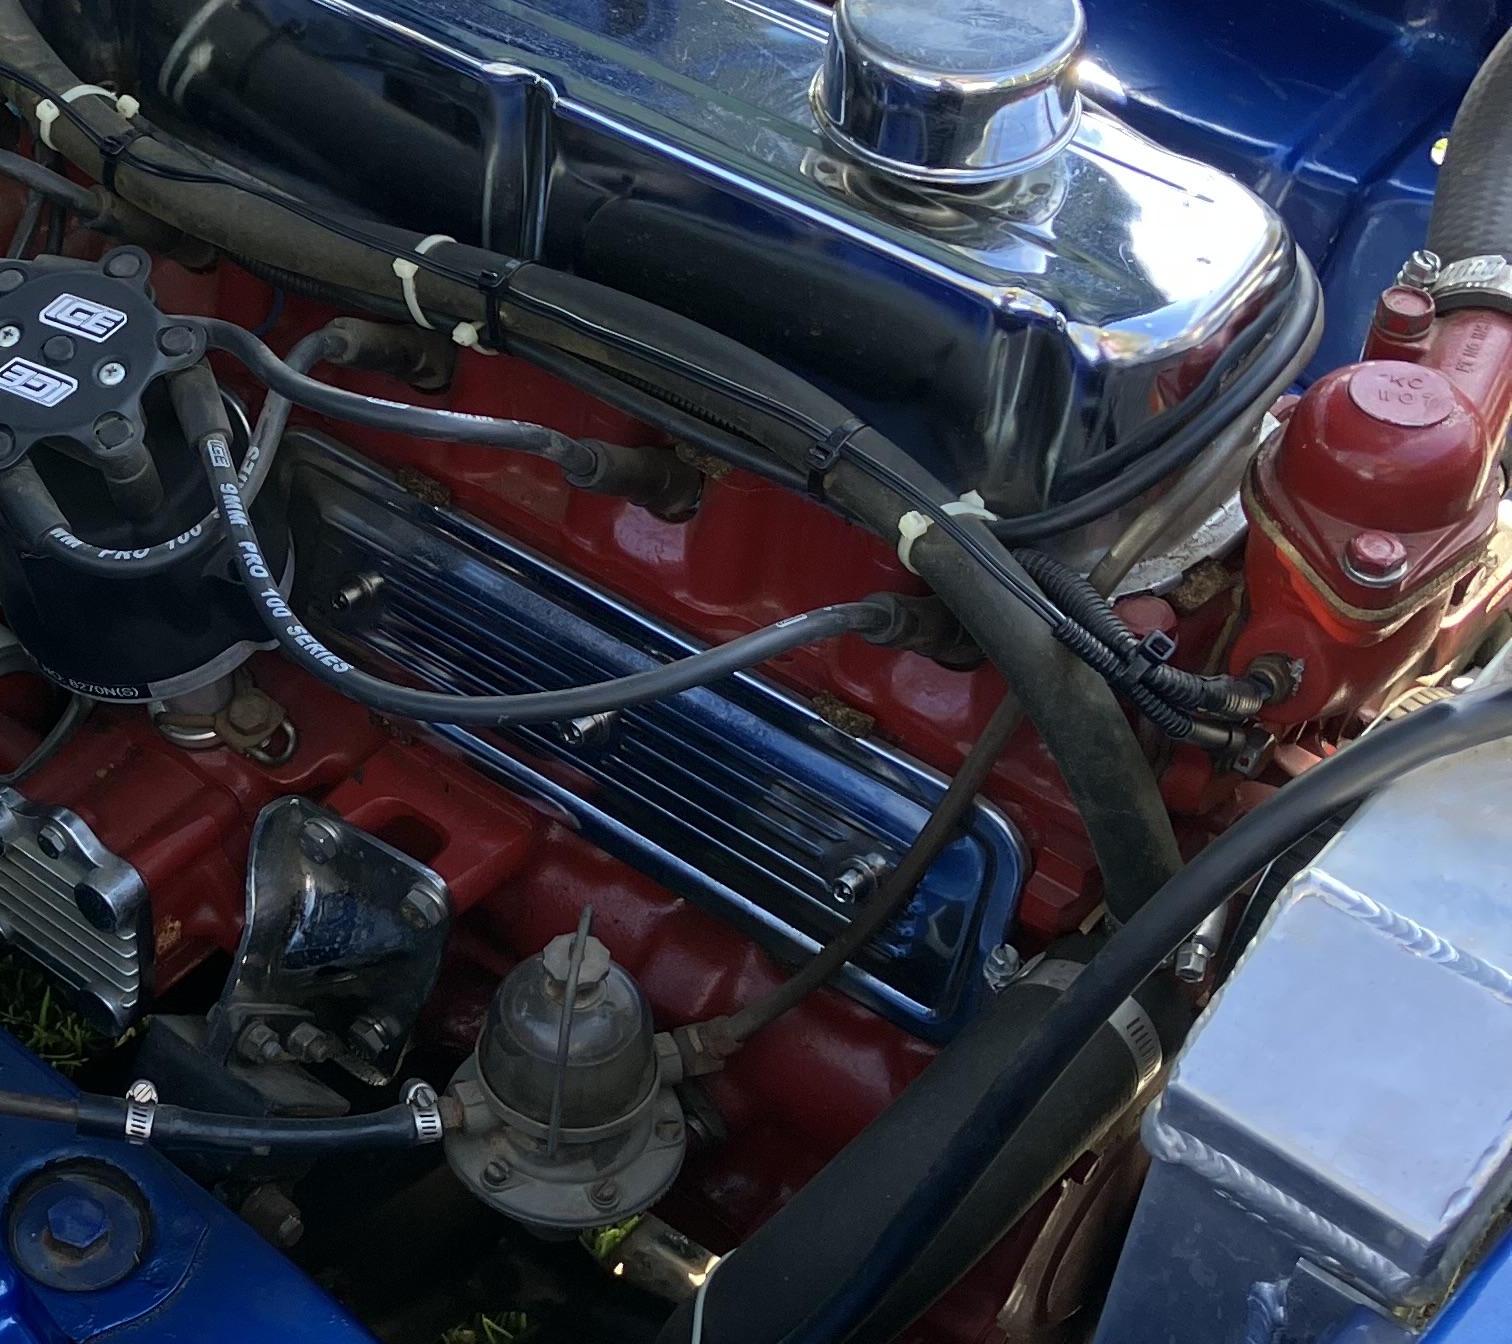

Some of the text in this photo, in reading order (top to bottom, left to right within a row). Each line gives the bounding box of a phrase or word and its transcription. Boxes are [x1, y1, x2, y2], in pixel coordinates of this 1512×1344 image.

[39, 293, 128, 343] ICE
[220, 483, 248, 526] 9MM
[238, 541, 269, 579] PRO
[261, 587, 291, 618] 100
[287, 625, 354, 673] SERIES
